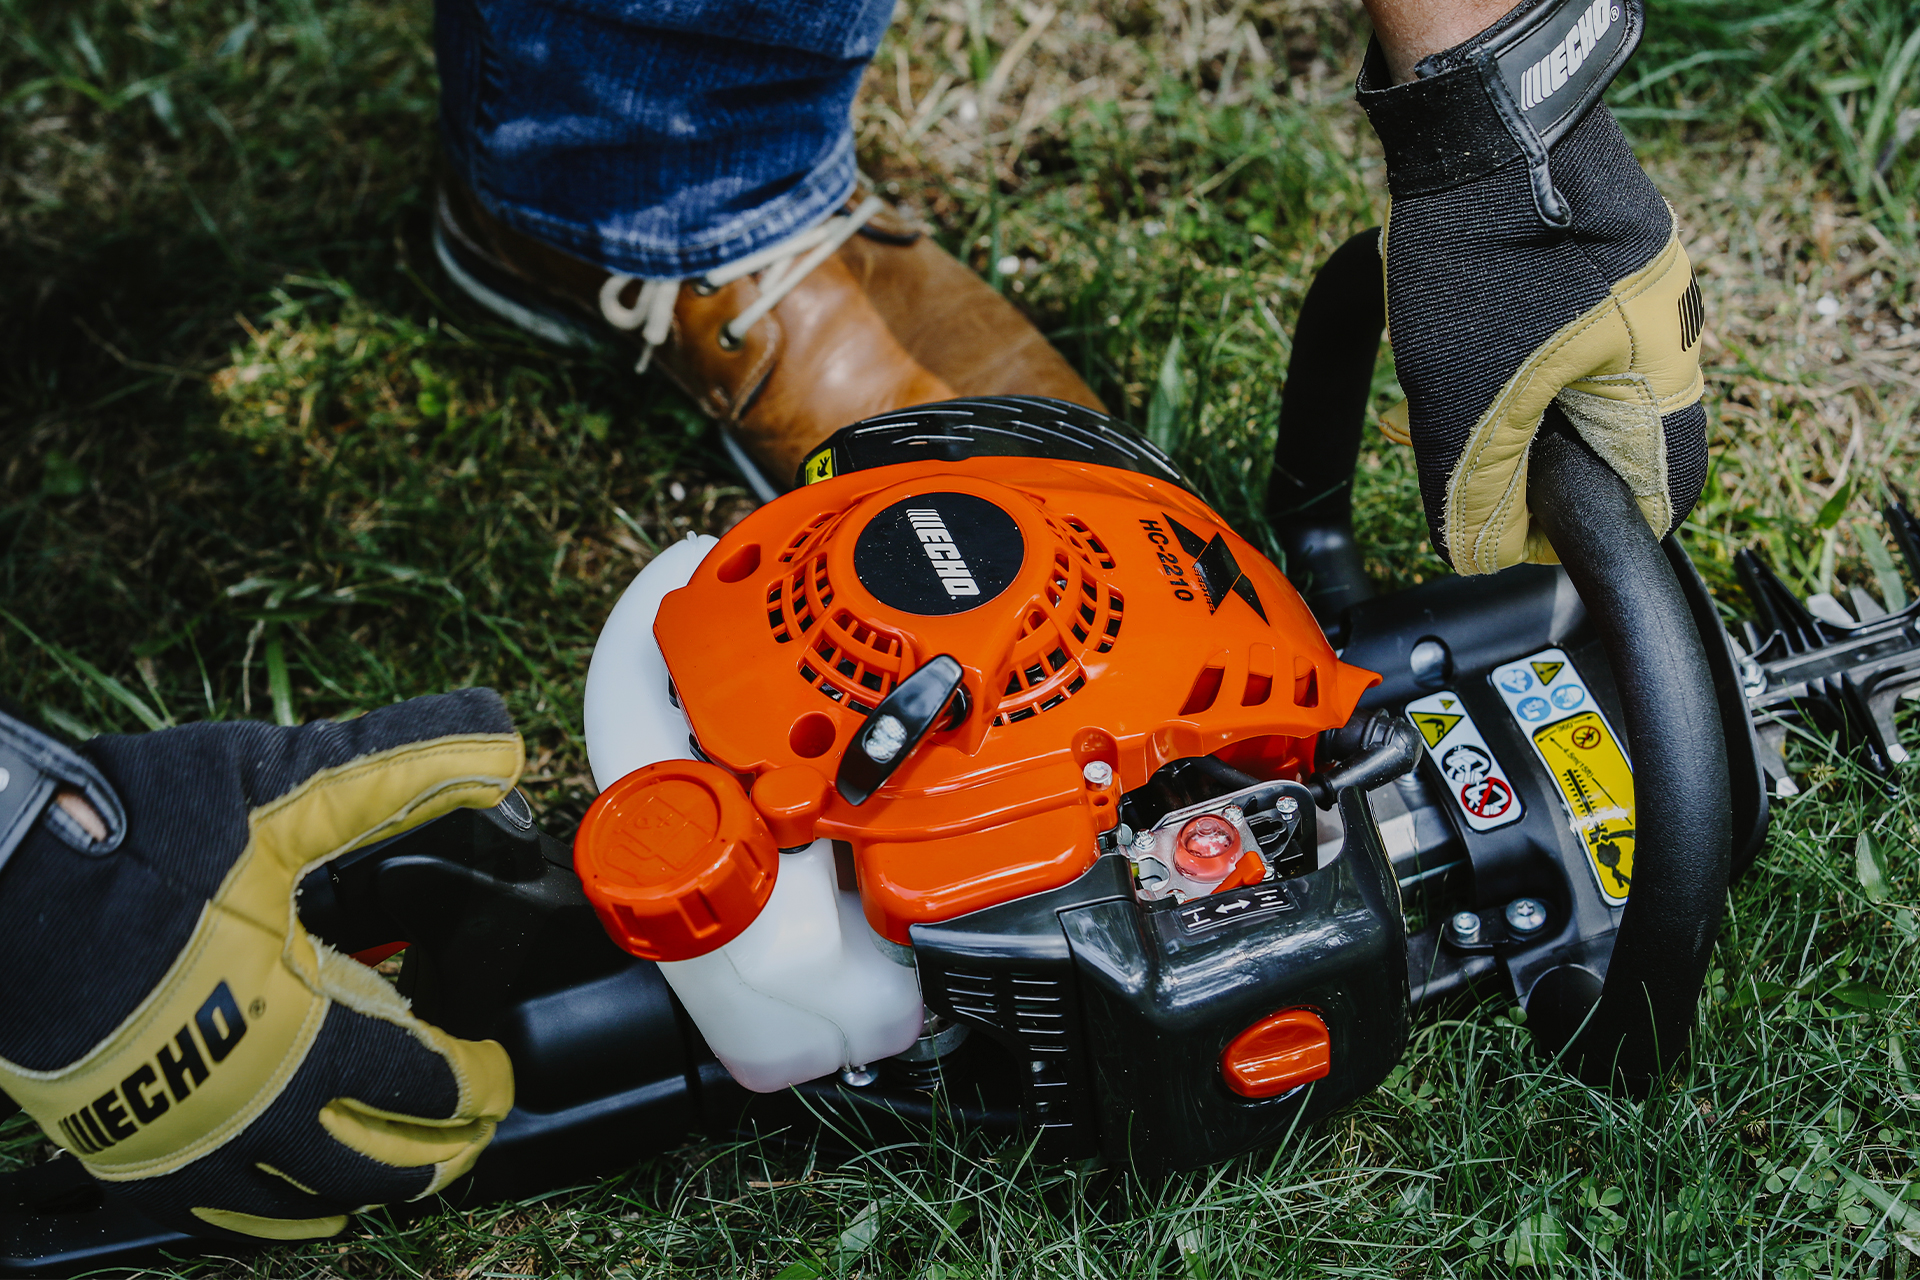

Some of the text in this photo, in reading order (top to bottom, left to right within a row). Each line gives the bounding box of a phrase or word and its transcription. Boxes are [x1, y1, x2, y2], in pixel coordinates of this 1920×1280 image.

[915, 528, 980, 595] ECHO
[1139, 519, 1194, 601] HC-2210
[91, 979, 247, 1142] ECHO
